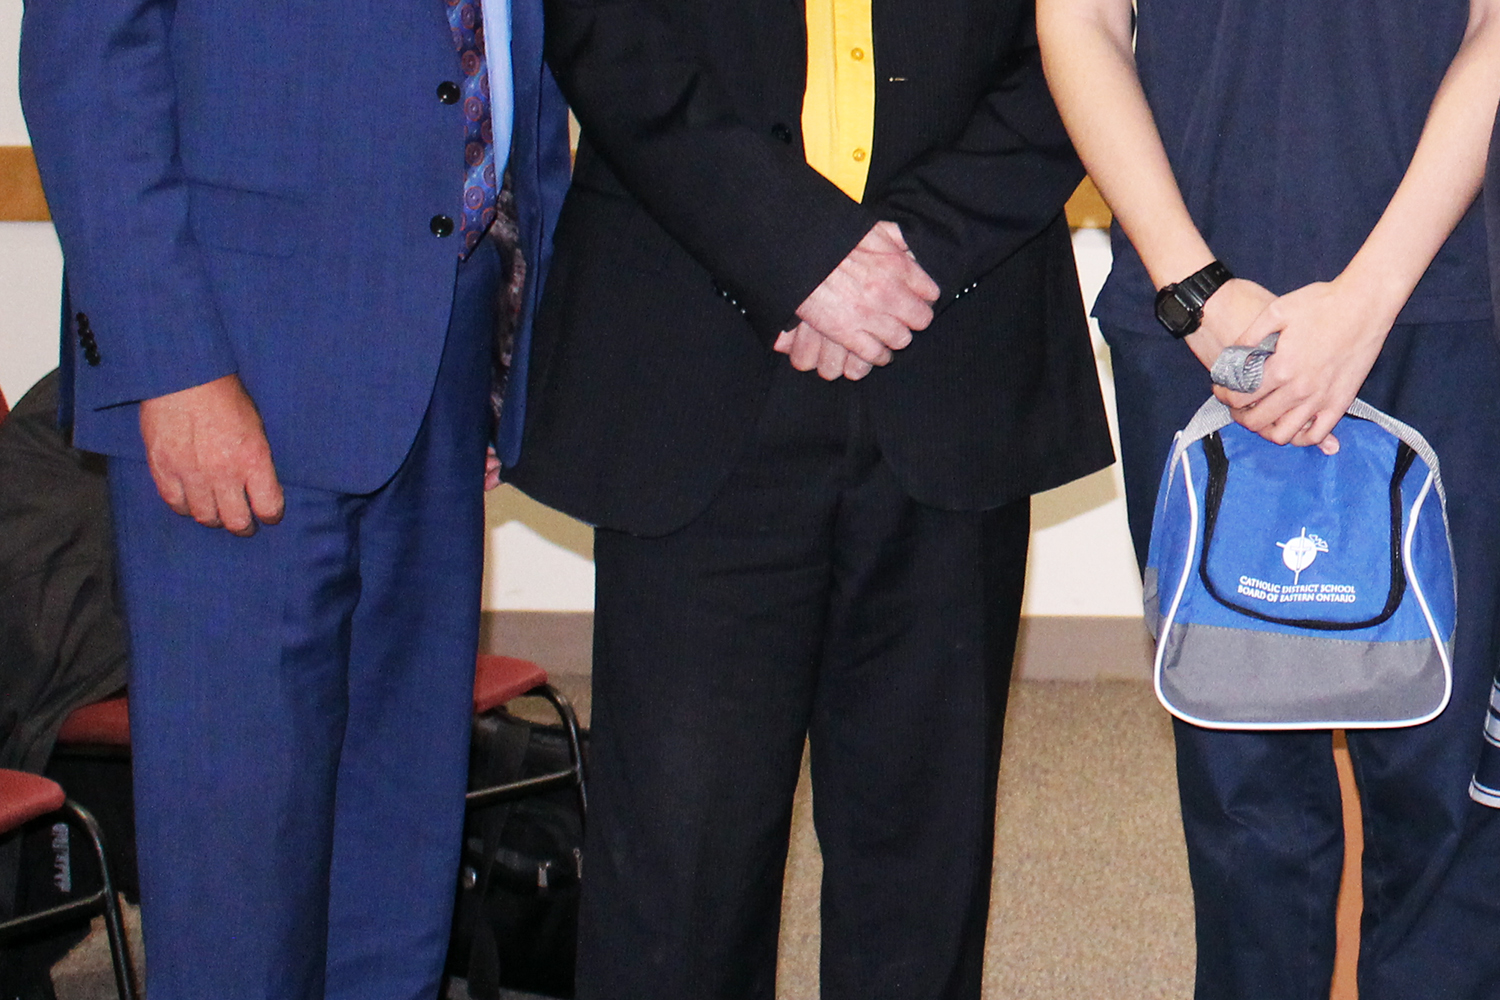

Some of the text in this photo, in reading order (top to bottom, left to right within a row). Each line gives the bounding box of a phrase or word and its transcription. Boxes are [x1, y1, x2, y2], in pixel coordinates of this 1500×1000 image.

[1237, 584, 1356, 604] BOARD OF EASTERN ONTARIO
[1239, 575, 1356, 594] CATHOLIC DISTRICT SCHOOL
